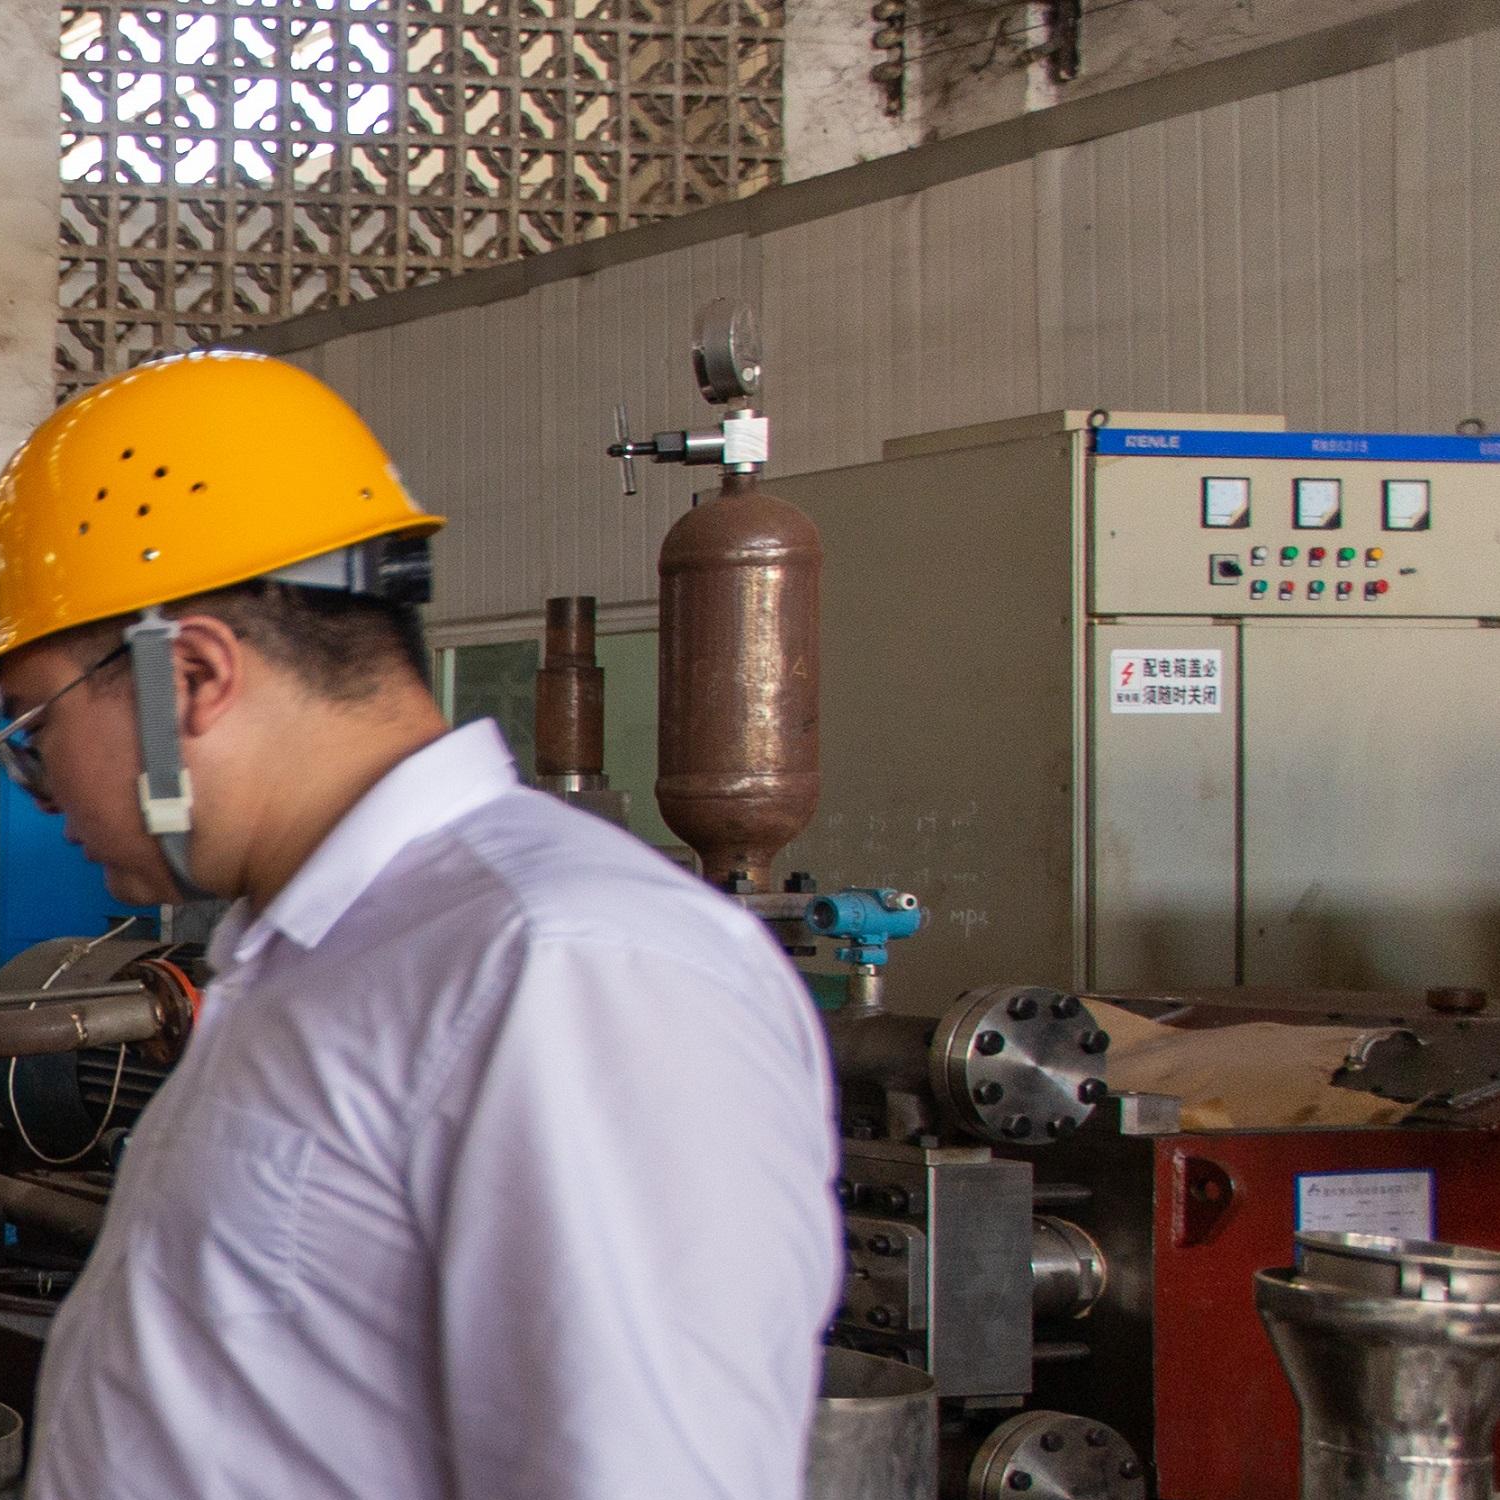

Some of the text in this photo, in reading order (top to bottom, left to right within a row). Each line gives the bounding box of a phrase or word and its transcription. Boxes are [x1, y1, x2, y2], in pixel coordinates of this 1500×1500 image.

[1143, 657, 1218, 678] 配电箱盖必
[1143, 685, 1217, 706] 须随时关闭
